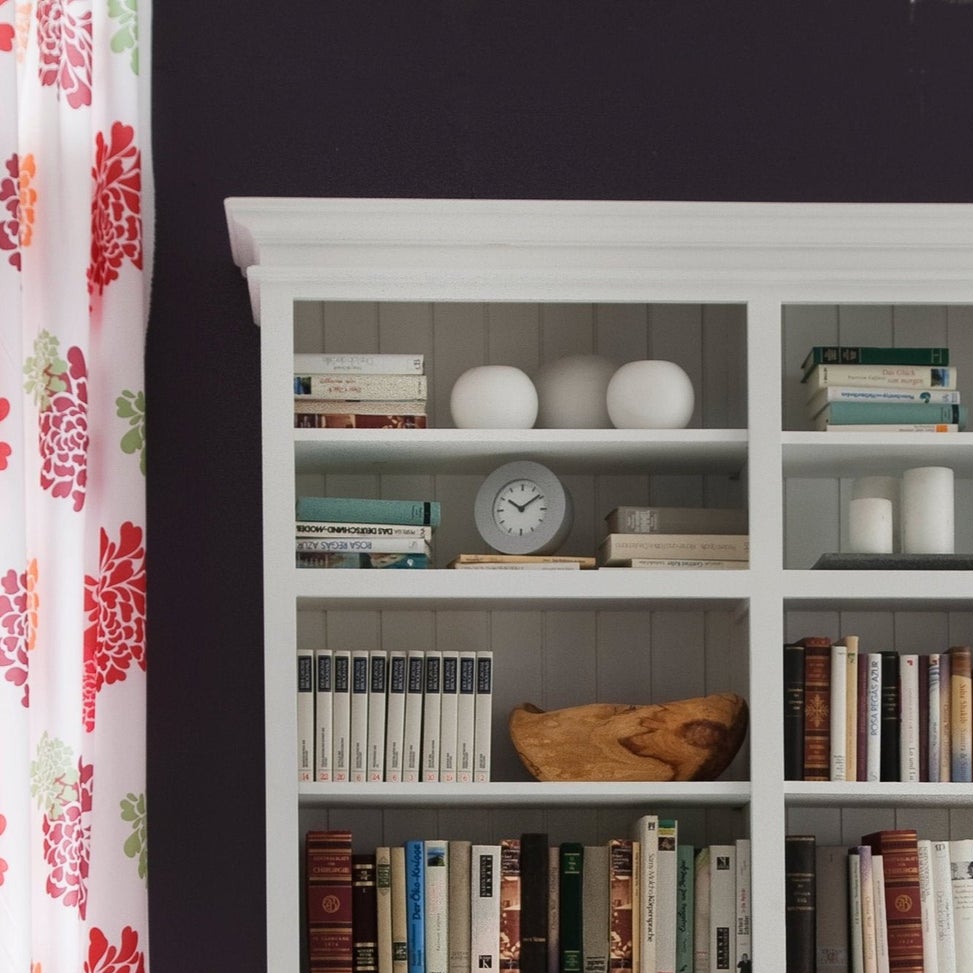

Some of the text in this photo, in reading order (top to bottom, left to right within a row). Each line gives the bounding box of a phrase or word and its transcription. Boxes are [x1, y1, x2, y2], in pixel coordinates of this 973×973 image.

[348, 541, 372, 550] ROSA
[870, 714, 878, 736] ROSA
[410, 844, 421, 901] Öko-Knigge
